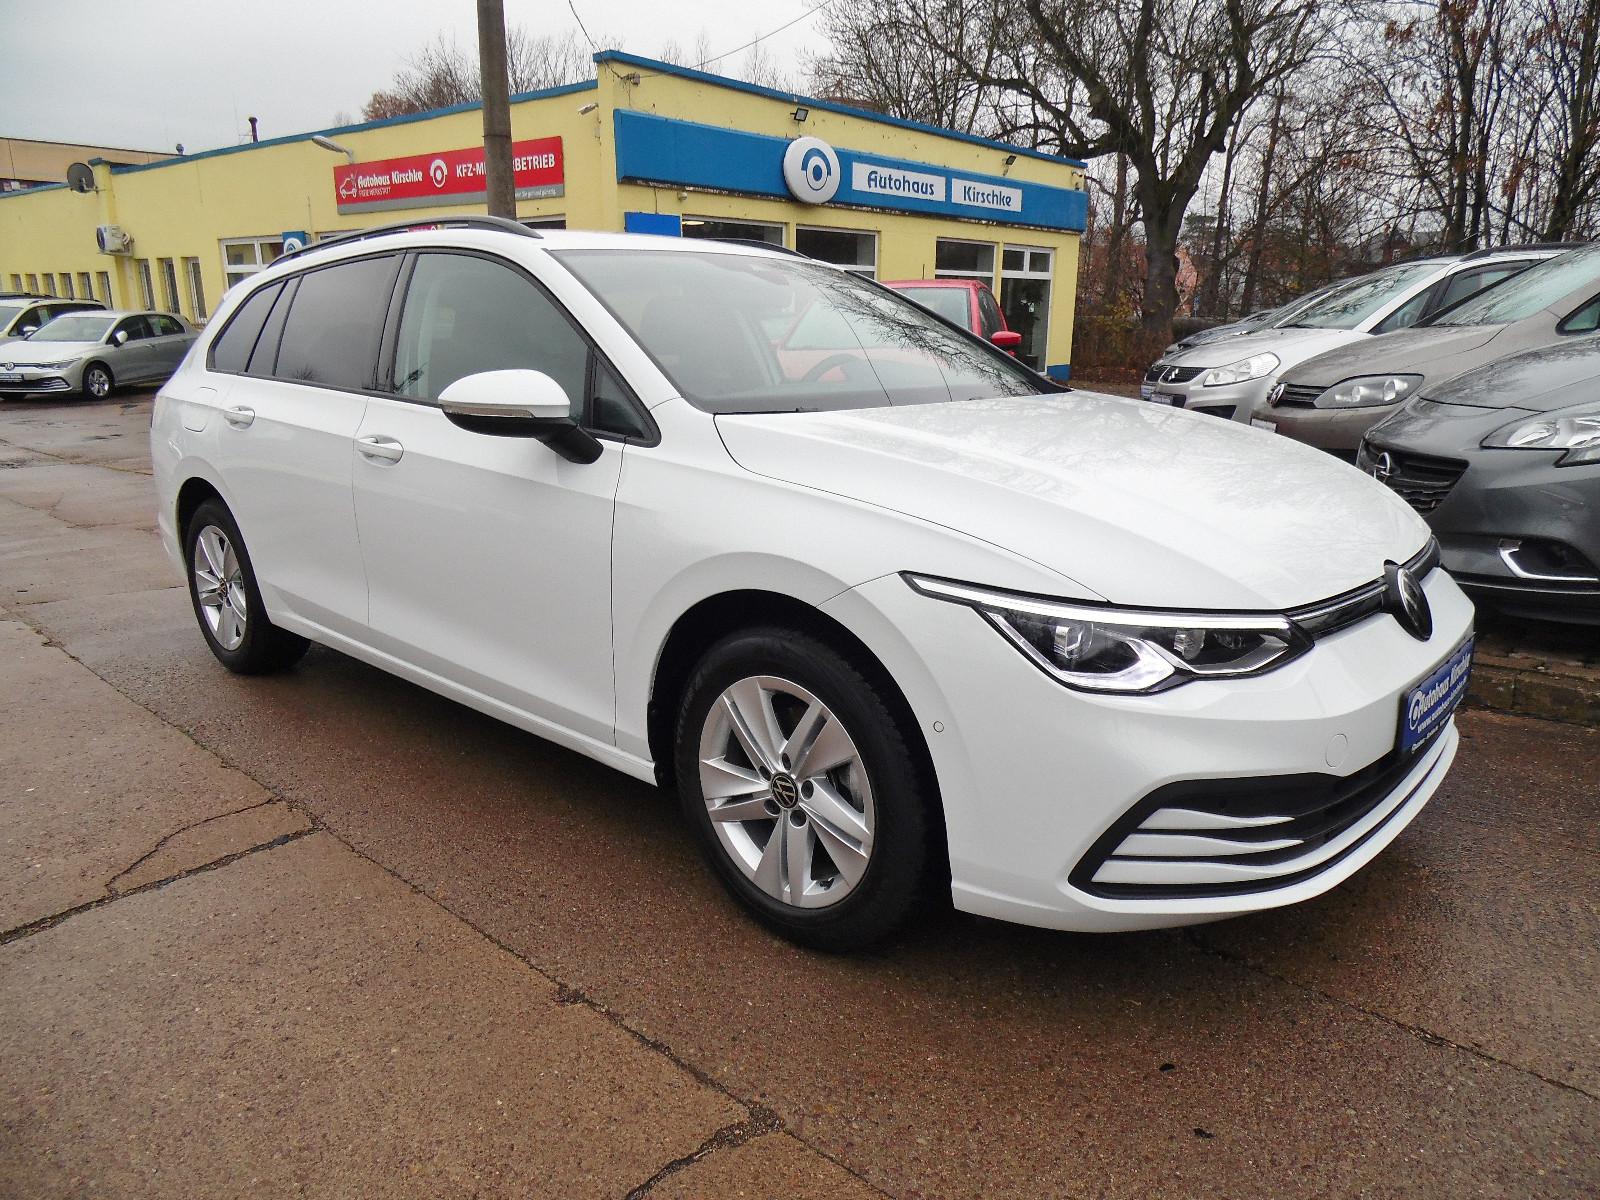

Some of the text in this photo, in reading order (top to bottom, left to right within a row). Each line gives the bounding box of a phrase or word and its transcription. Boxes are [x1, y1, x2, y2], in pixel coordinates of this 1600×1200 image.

[357, 168, 423, 189] Autohaus Kirschke
[867, 170, 1012, 207] Autohaus Kirschke
